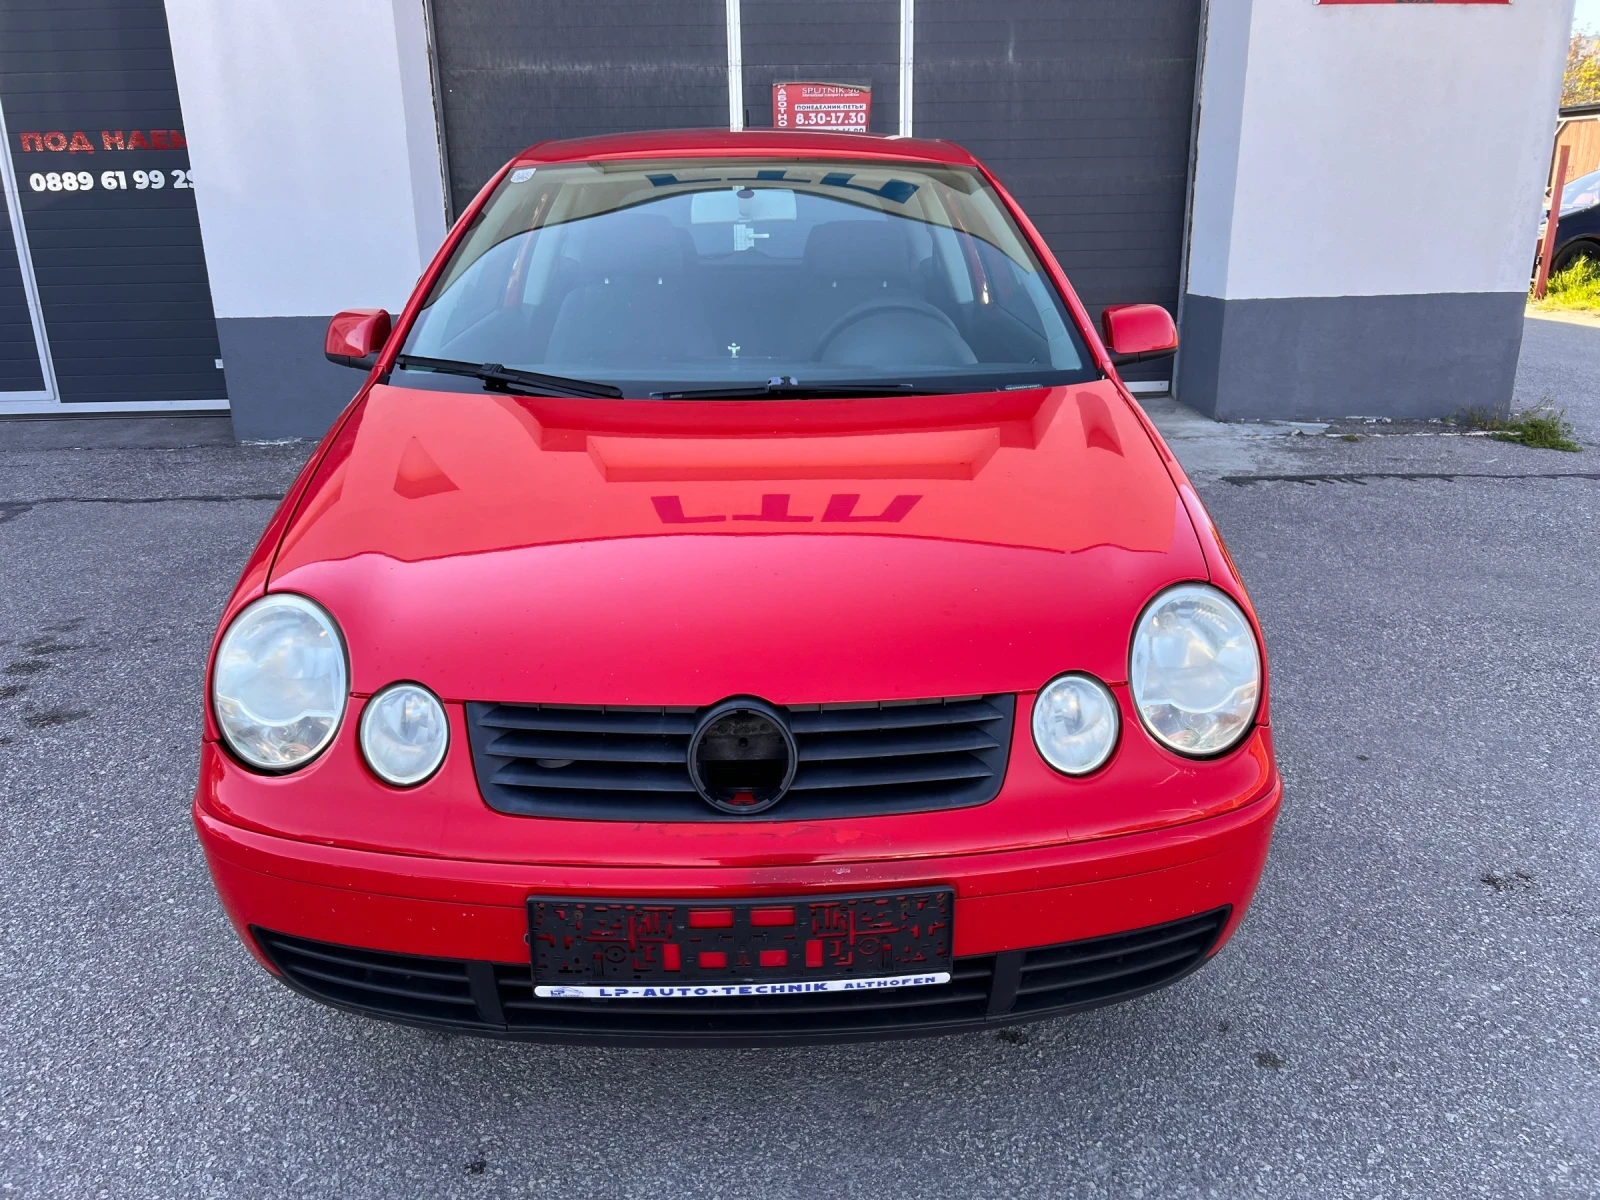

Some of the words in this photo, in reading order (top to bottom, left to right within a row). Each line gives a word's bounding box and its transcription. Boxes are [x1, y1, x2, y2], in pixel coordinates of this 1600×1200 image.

[795, 112, 866, 124] 8.30-17.30
[19, 131, 95, 154] ПОД
[29, 171, 95, 192] 0889
[100, 170, 127, 190] 61
[132, 169, 166, 190] 99
[844, 976, 936, 989] ALTHOFEN
